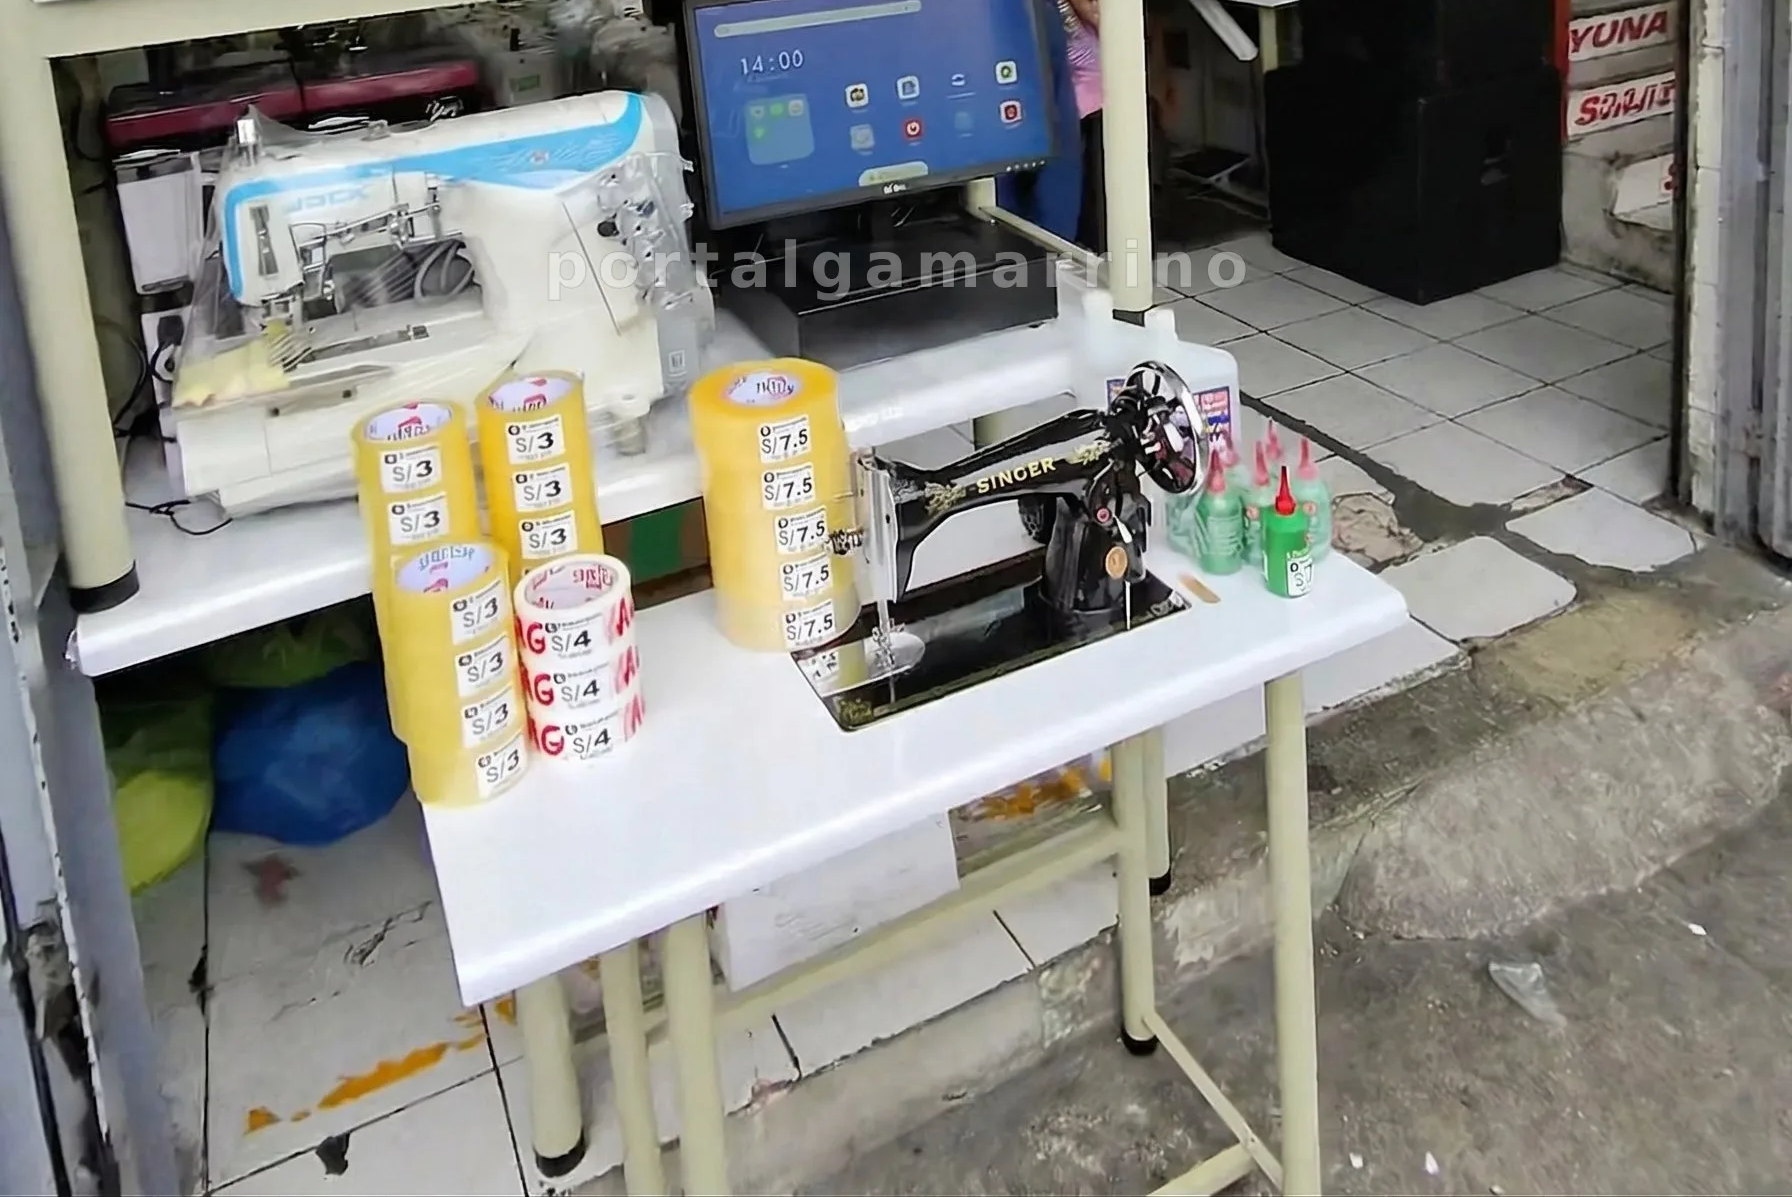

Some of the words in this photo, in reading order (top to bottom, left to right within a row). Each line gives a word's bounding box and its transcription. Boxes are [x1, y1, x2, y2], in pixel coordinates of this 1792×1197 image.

[740, 49, 804, 76] 14:00
[514, 431, 555, 454] S/3
[760, 428, 808, 454] S/7.5
[392, 459, 433, 483] S/3
[976, 458, 1056, 495] SINGER
[522, 480, 562, 502] S/3
[764, 476, 812, 502] S/7.5
[400, 509, 441, 534] S/3
[778, 519, 825, 546] S/7.5
[528, 528, 567, 550] S/3
[783, 563, 829, 592] S/7.5
[463, 597, 499, 628] S/3
[786, 612, 833, 641] S/7.5
[551, 629, 592, 653] S/4
[467, 651, 504, 683] S/3
[561, 679, 600, 703] S/4
[472, 703, 509, 736] S/3
[573, 727, 611, 754] S/4
[486, 749, 520, 783] S/3
